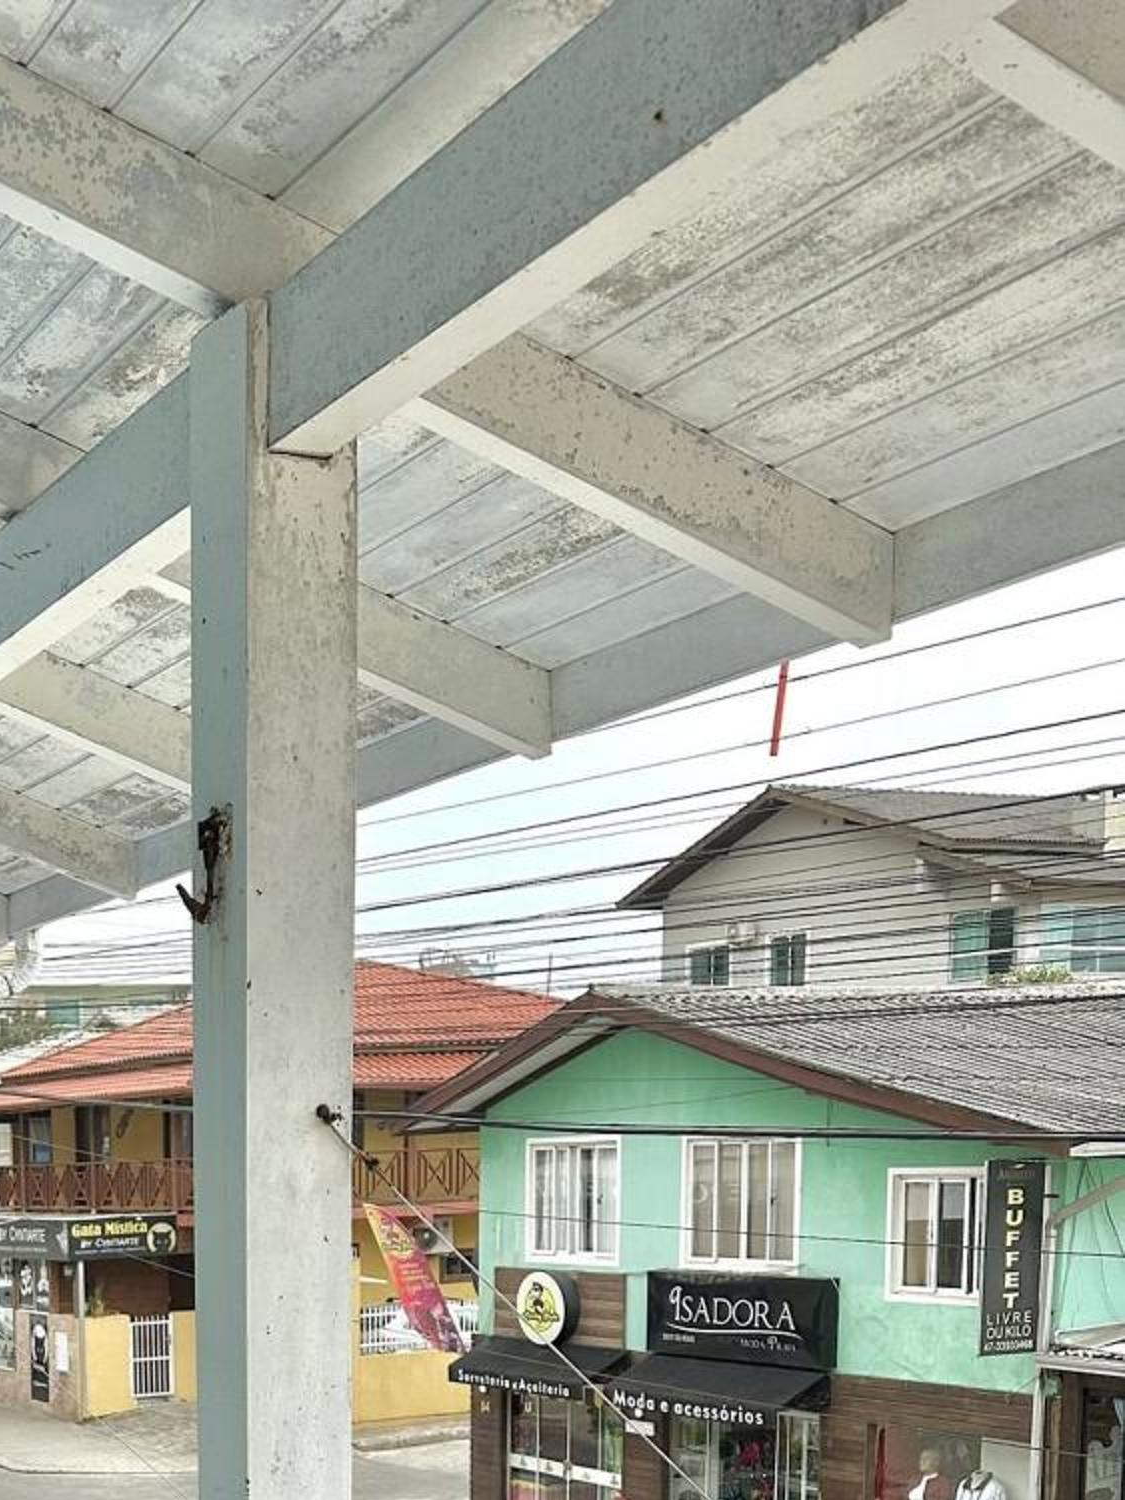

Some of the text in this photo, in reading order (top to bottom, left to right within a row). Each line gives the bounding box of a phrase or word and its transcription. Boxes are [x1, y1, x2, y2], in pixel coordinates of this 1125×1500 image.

[71, 1222, 102, 1238] Gata
[1002, 1188, 1024, 1309] BUFFET
[668, 1285, 796, 1330] ISADORA
[986, 1310, 1032, 1326] LIVRE
[1004, 1324, 1032, 1339] KILO
[613, 1389, 764, 1425] Moda e acessórios
